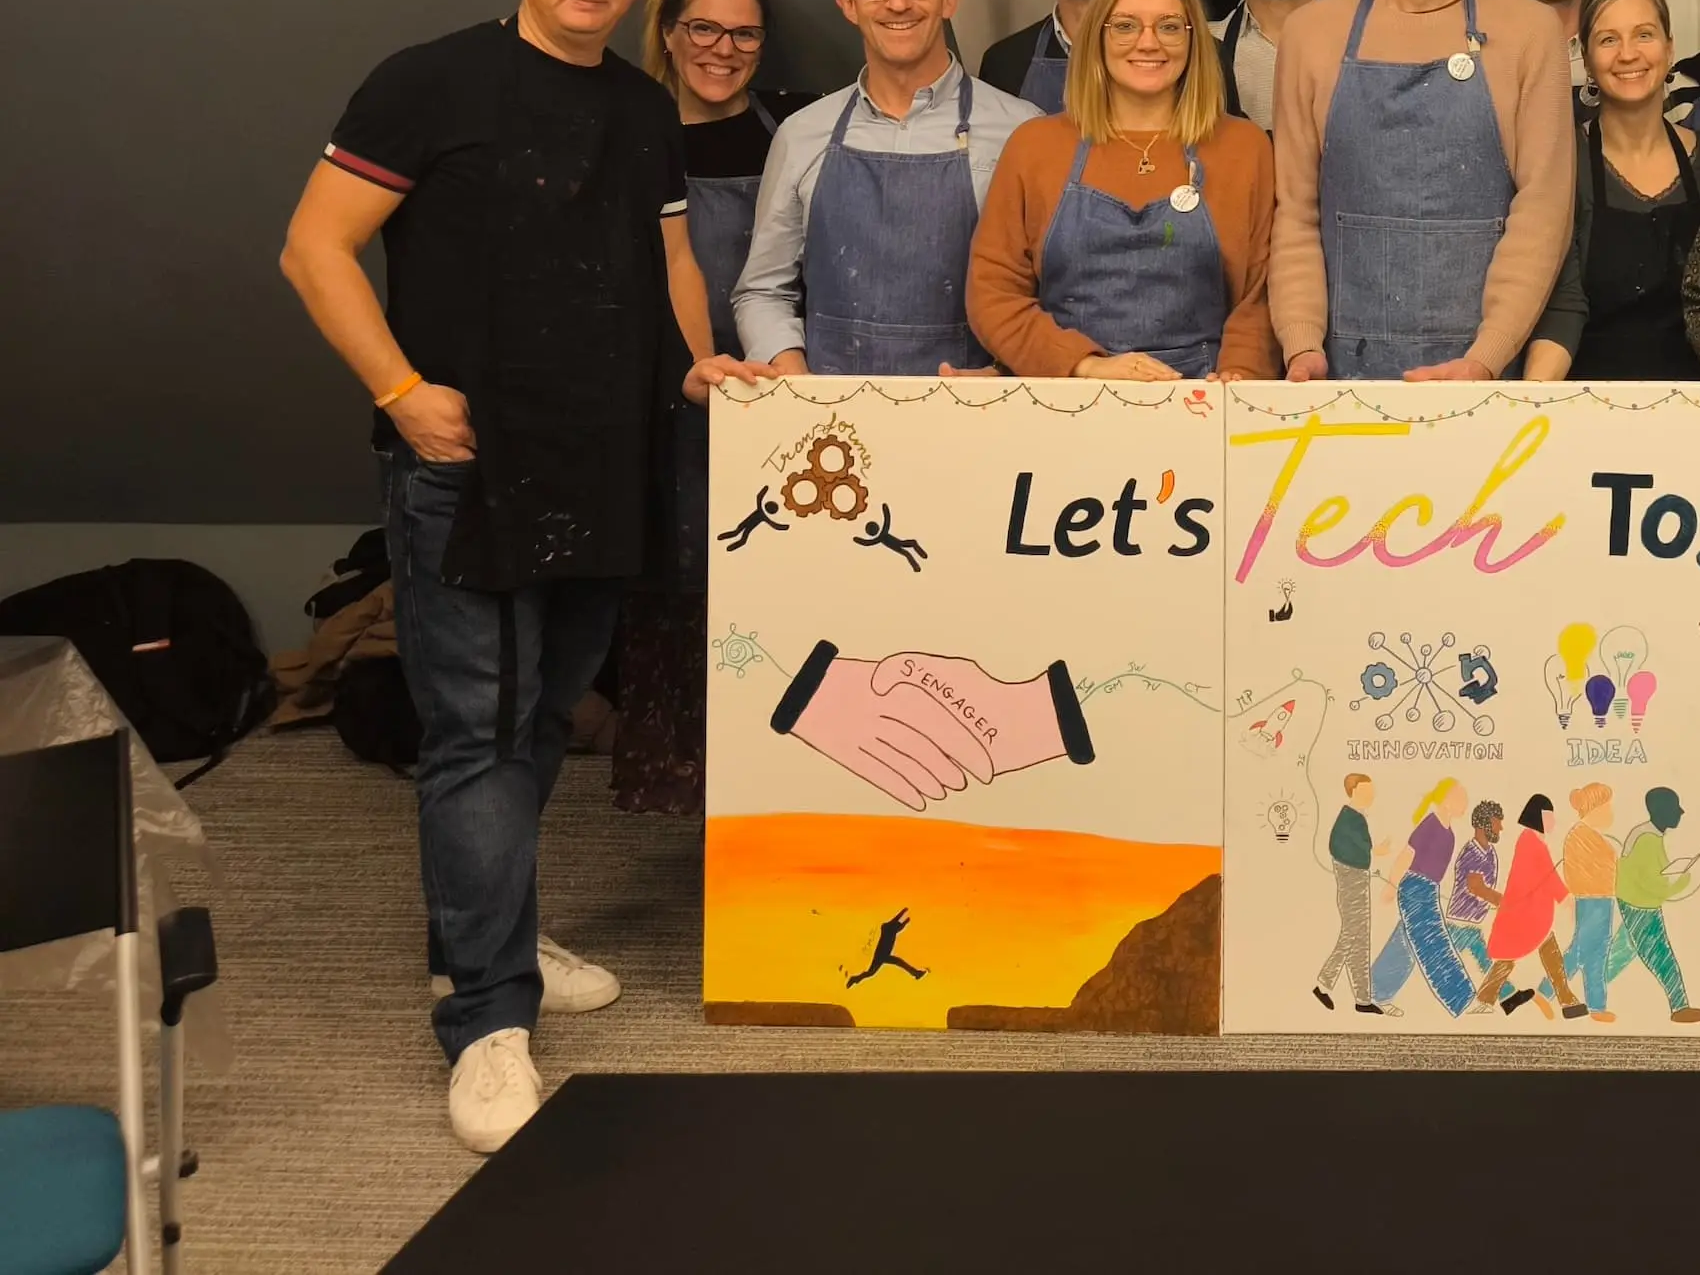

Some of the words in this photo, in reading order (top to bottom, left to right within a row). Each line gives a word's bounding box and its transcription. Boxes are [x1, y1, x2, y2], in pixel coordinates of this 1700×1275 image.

[761, 410, 872, 480] Transformer
[1005, 469, 1215, 557] Let's
[1229, 413, 1567, 584] Tech
[900, 659, 998, 745] S'ENGAGER
[1567, 738, 1648, 767] IDEA
